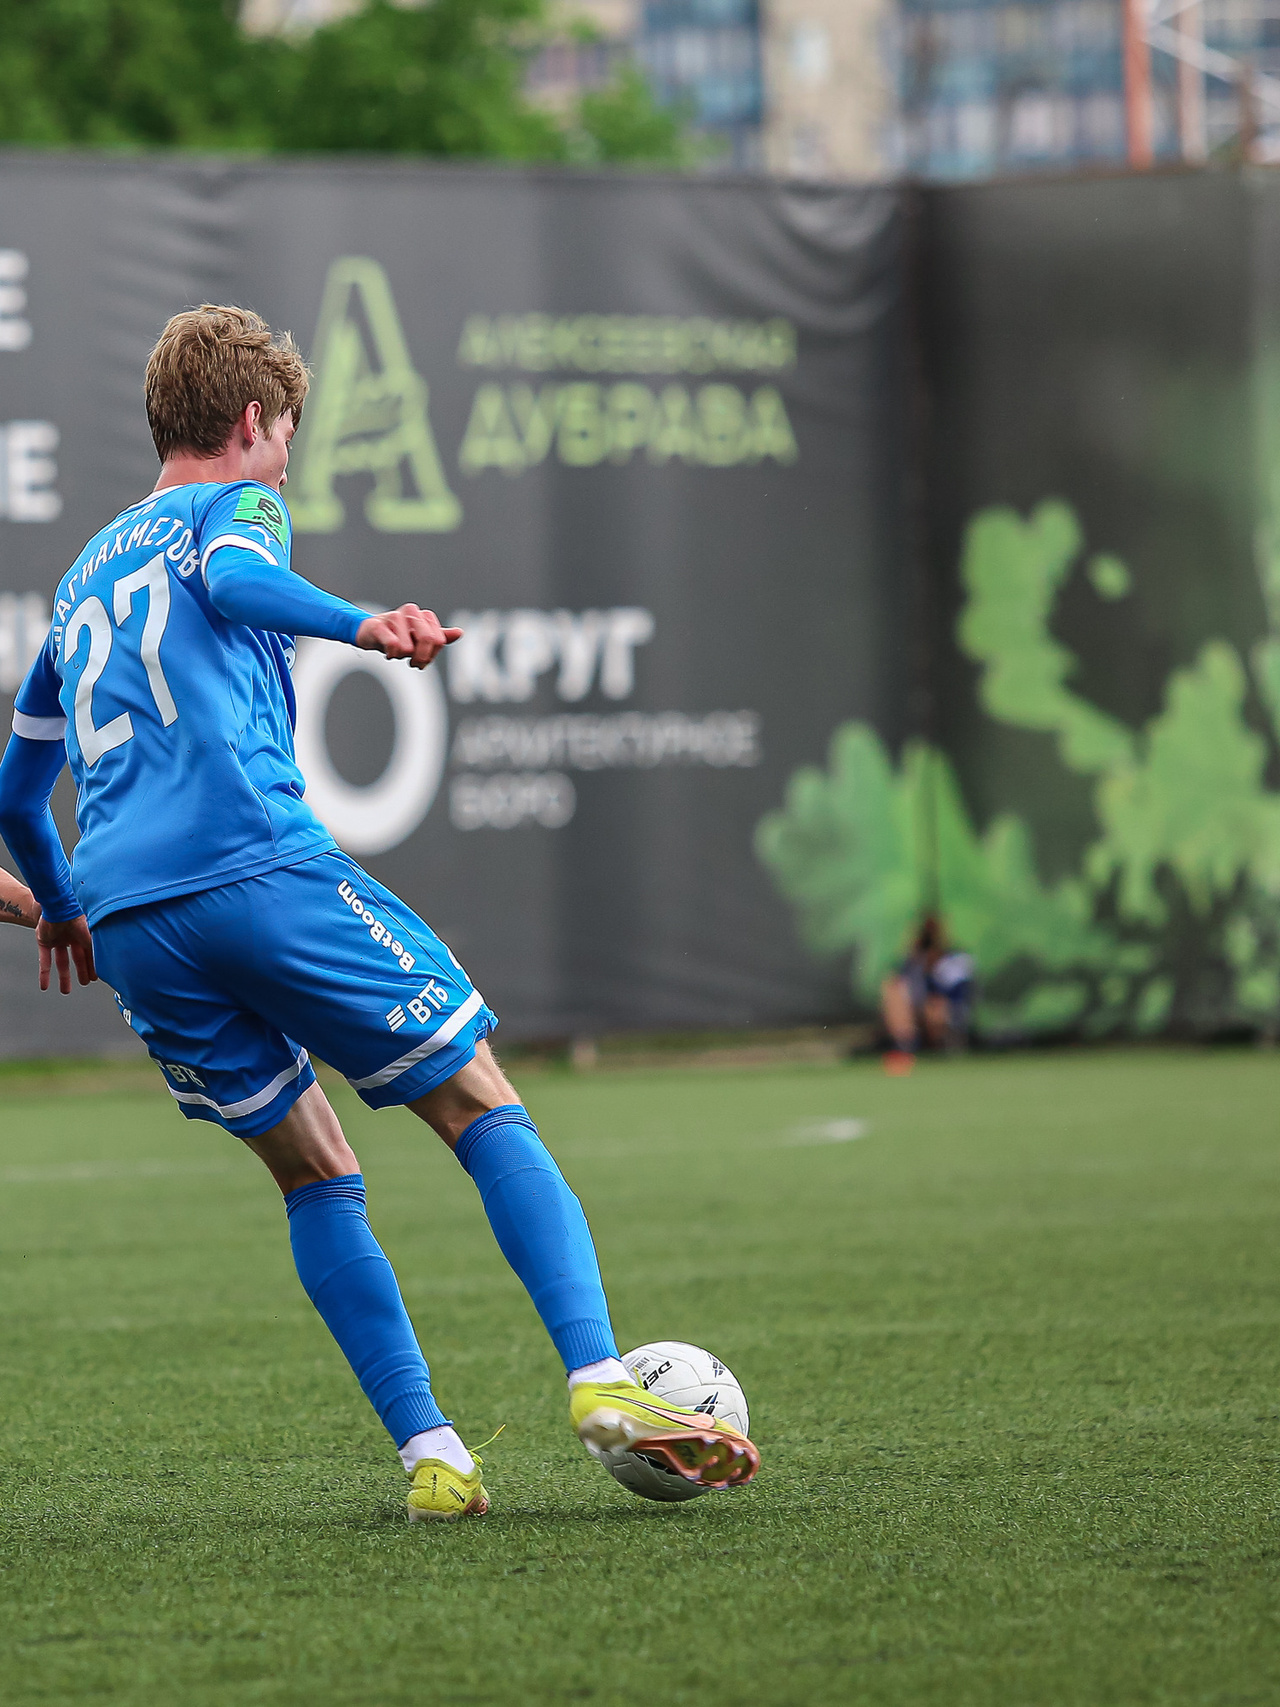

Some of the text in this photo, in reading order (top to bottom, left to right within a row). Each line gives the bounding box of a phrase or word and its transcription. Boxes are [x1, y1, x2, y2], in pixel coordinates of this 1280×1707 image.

[458, 381, 799, 476] ДУБРАВА
[64, 551, 179, 768] 27
[447, 606, 655, 702] КРУГ
[337, 879, 416, 973] BetBoom
[406, 978, 449, 1025] ВТБ
